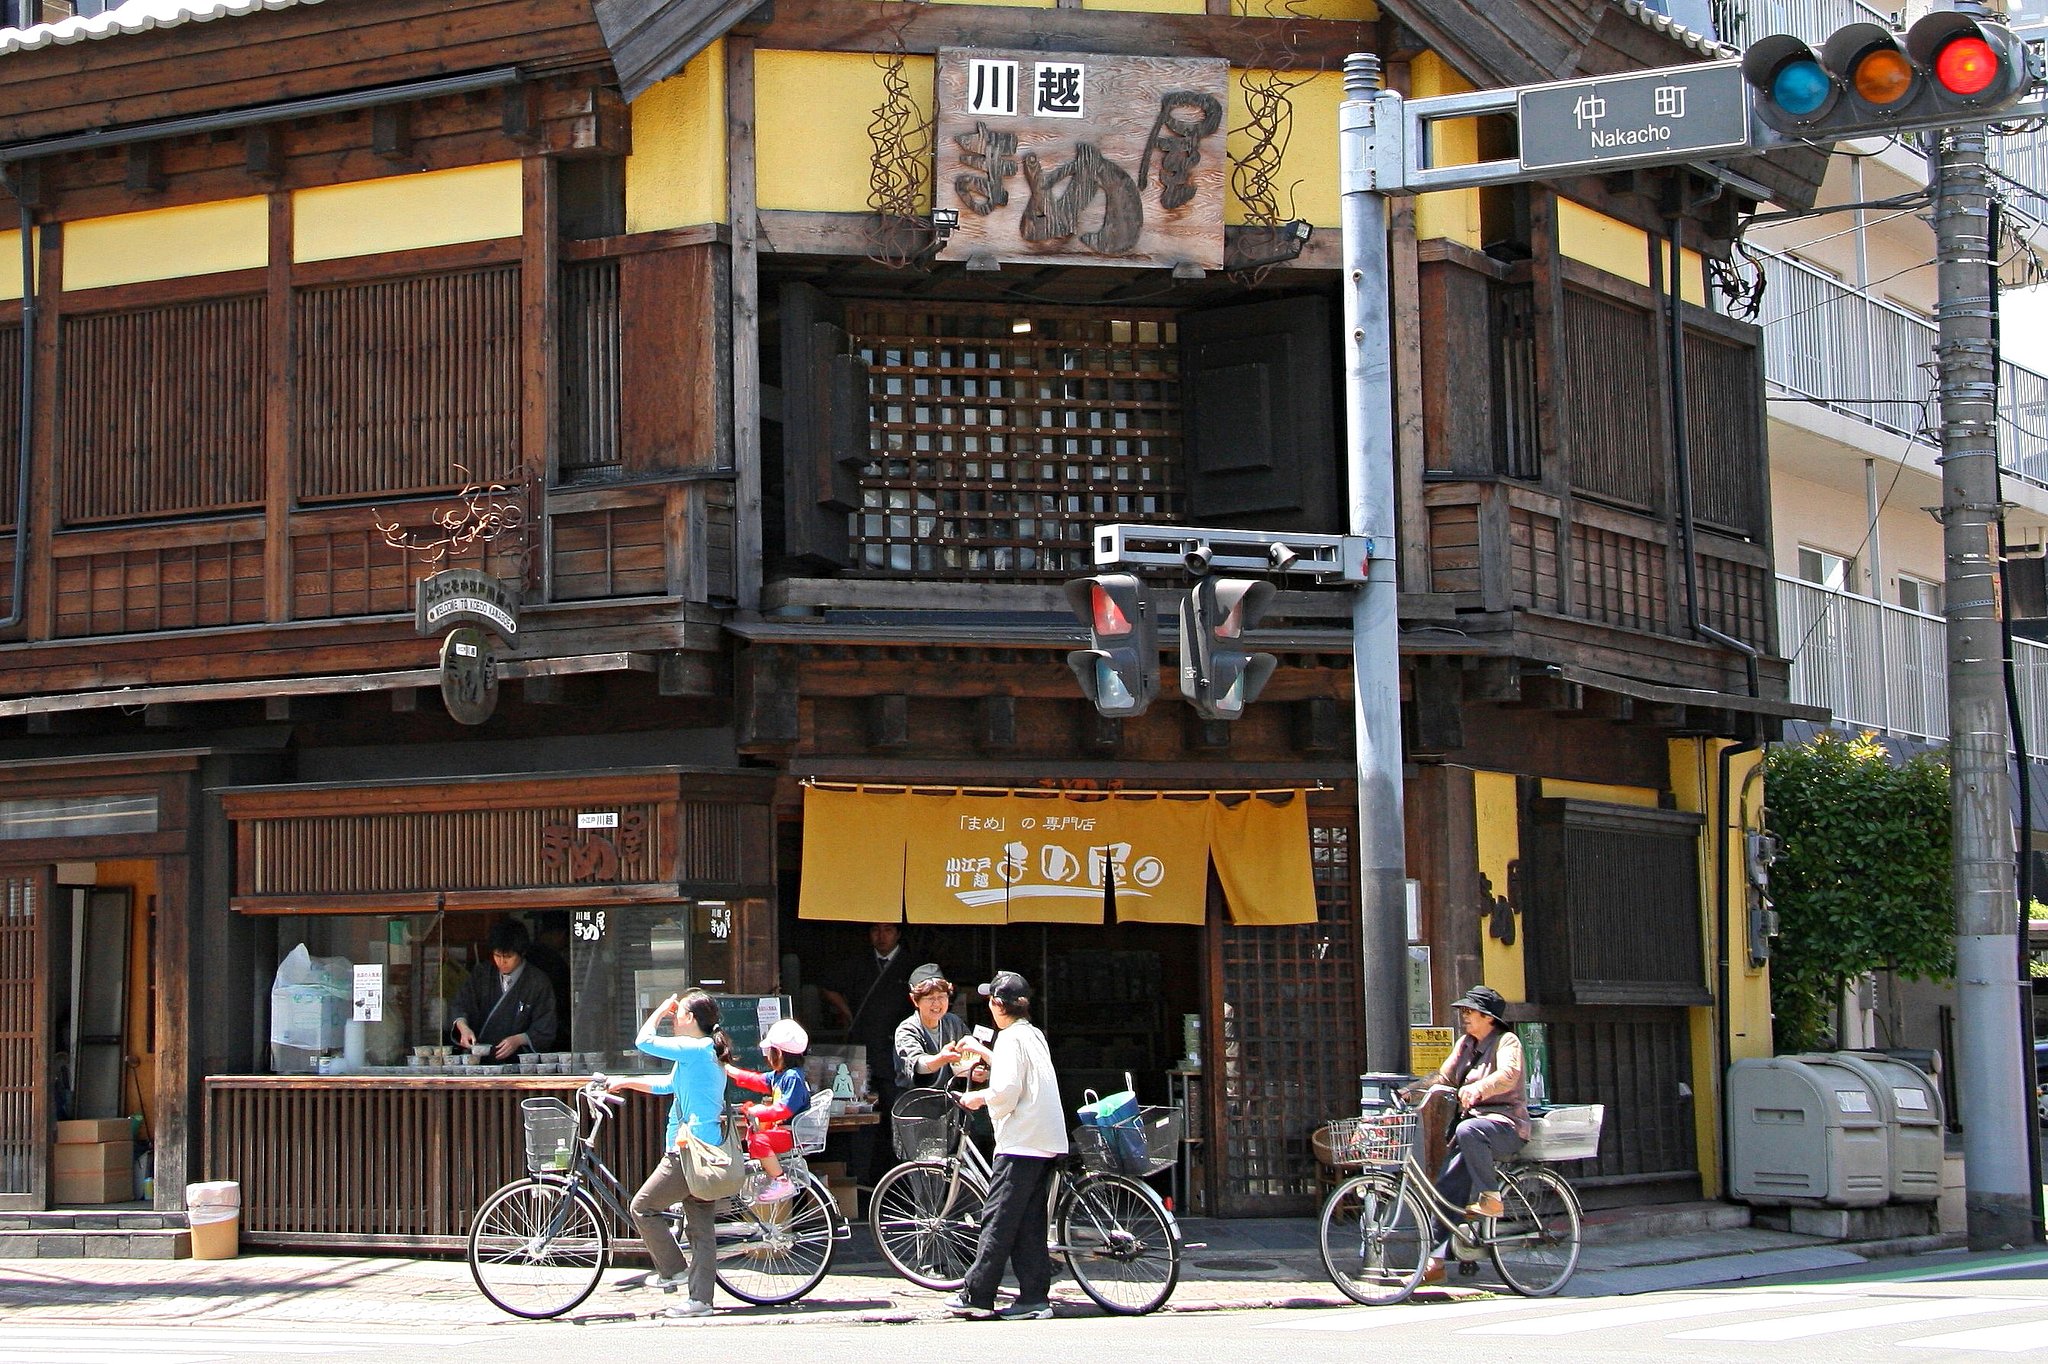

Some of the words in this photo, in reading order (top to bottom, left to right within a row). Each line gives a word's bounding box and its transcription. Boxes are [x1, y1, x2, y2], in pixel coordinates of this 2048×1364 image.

[972, 65, 1081, 113] 川越
[1572, 86, 1688, 130] 仲町
[1591, 124, 1671, 148] Nakacho
[953, 89, 1224, 254] まめ屋
[460, 599, 468, 609] TO
[1042, 816, 1097, 832] 専門店
[946, 857, 992, 873] 小江戸
[945, 873, 990, 888] 川越
